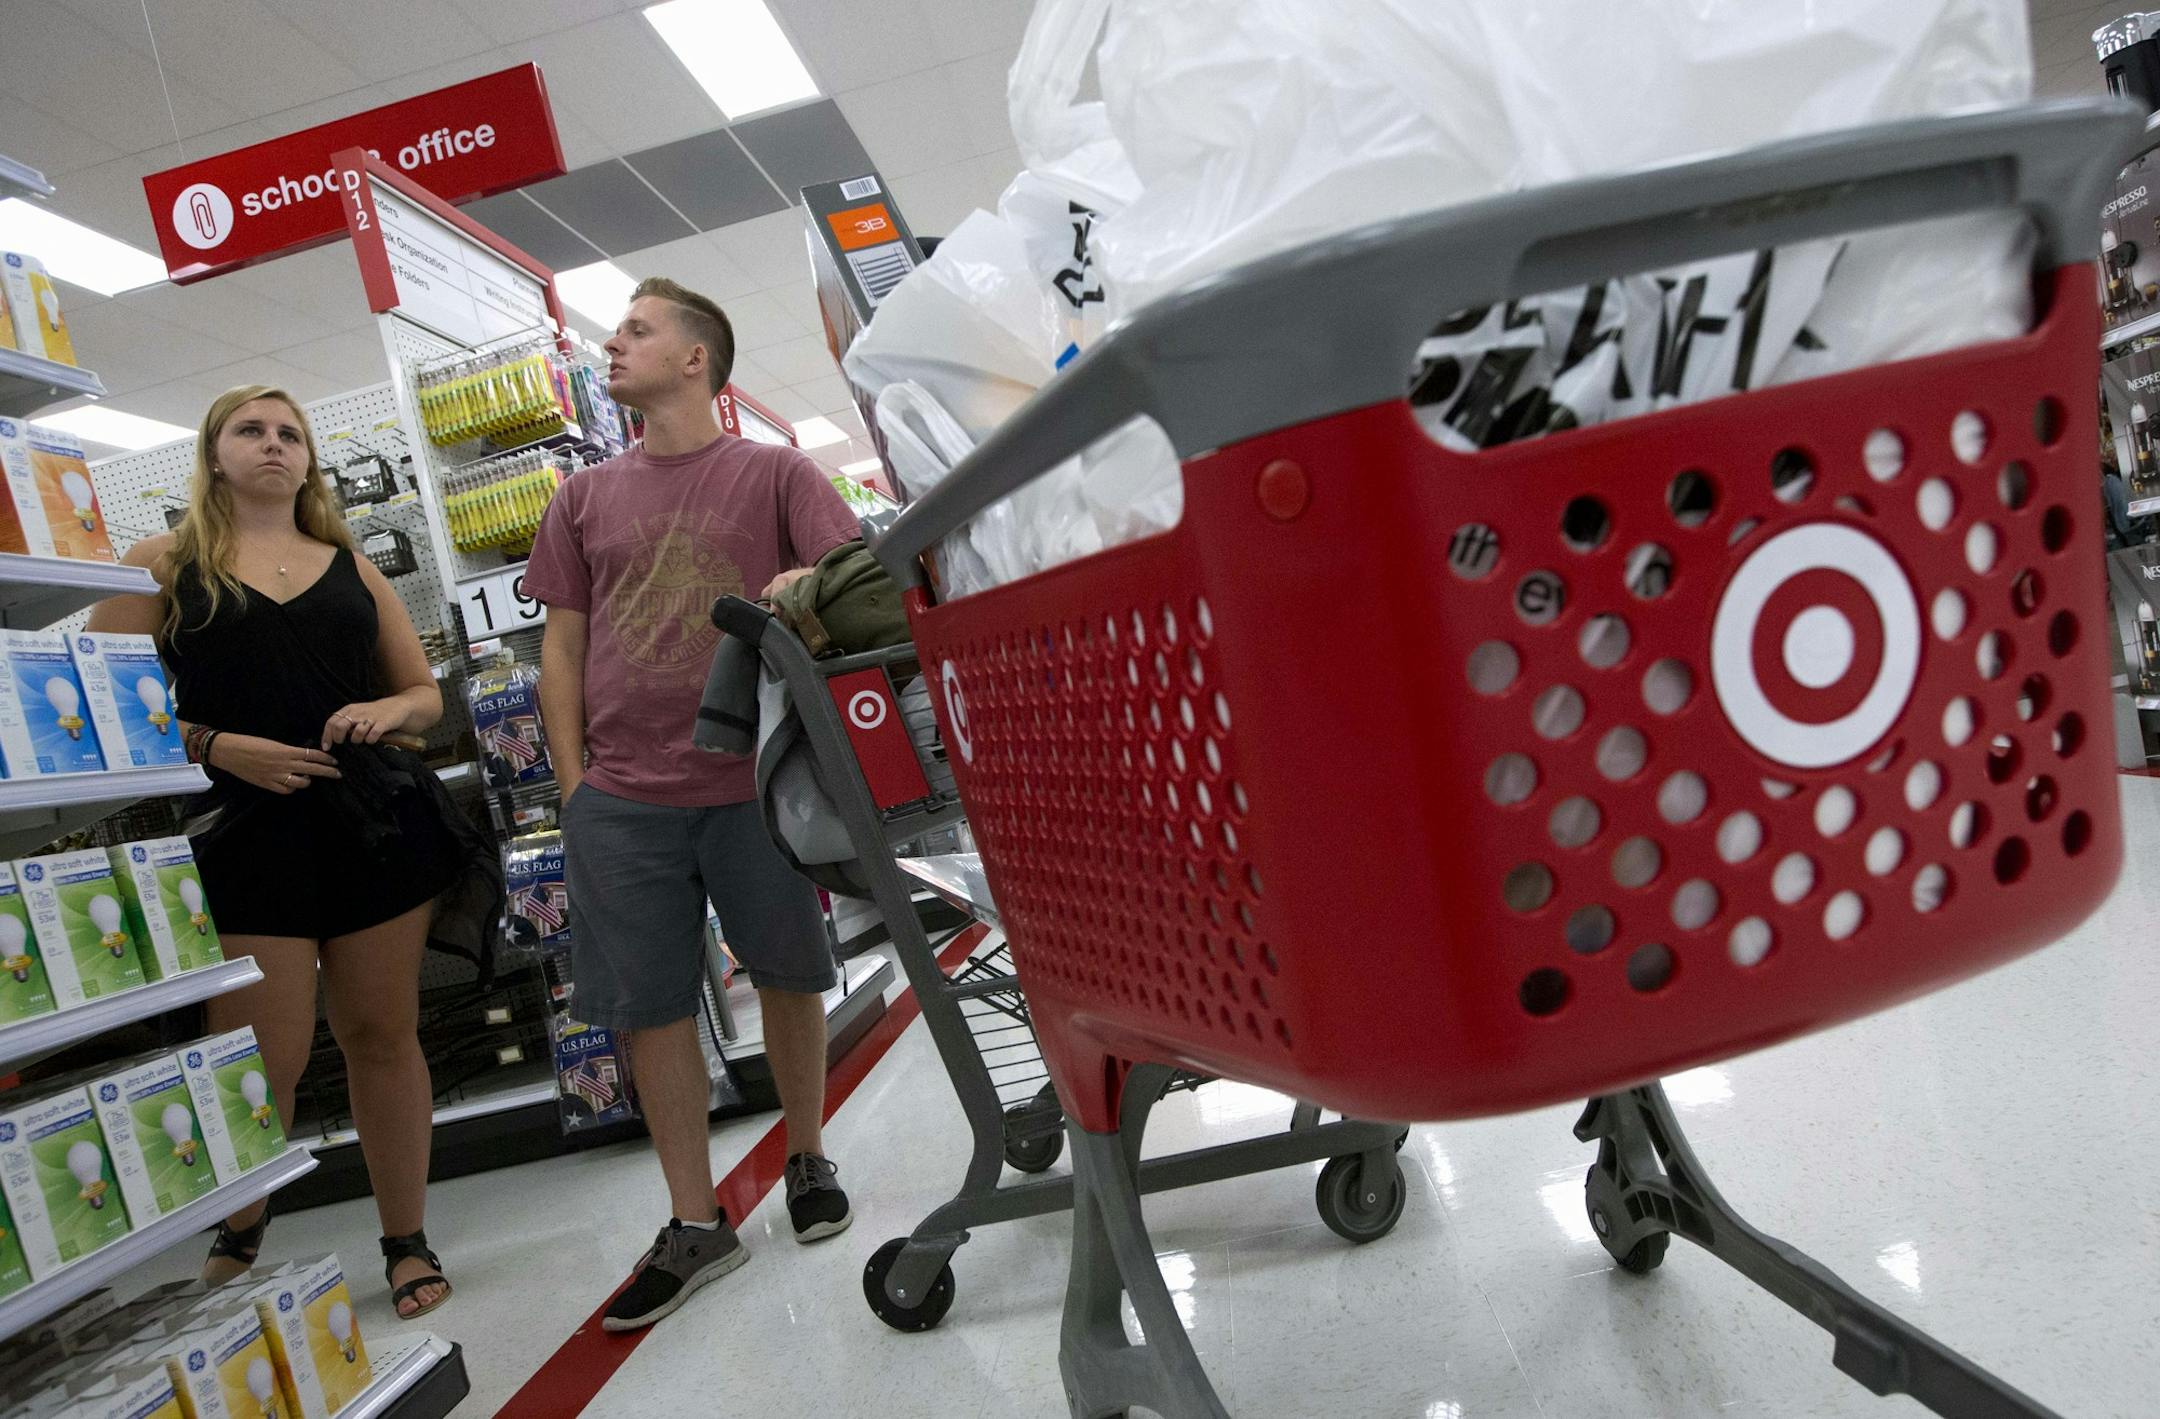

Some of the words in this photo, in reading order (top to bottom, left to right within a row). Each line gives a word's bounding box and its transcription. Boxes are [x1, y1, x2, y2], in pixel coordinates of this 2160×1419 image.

[241, 168, 340, 217] schoo
[398, 123, 497, 171] office
[342, 169, 371, 232] D12
[855, 217, 887, 234] 3B
[397, 236, 449, 274] Organization
[398, 265, 431, 291] Folders
[719, 394, 735, 429] D10
[479, 701, 497, 713] U.S.
[498, 693, 525, 708] FLAG
[513, 863, 532, 875] U.S.
[533, 860, 561, 873] FLAG
[561, 1040, 579, 1053] U.S.
[580, 1034, 606, 1049] FLAG
